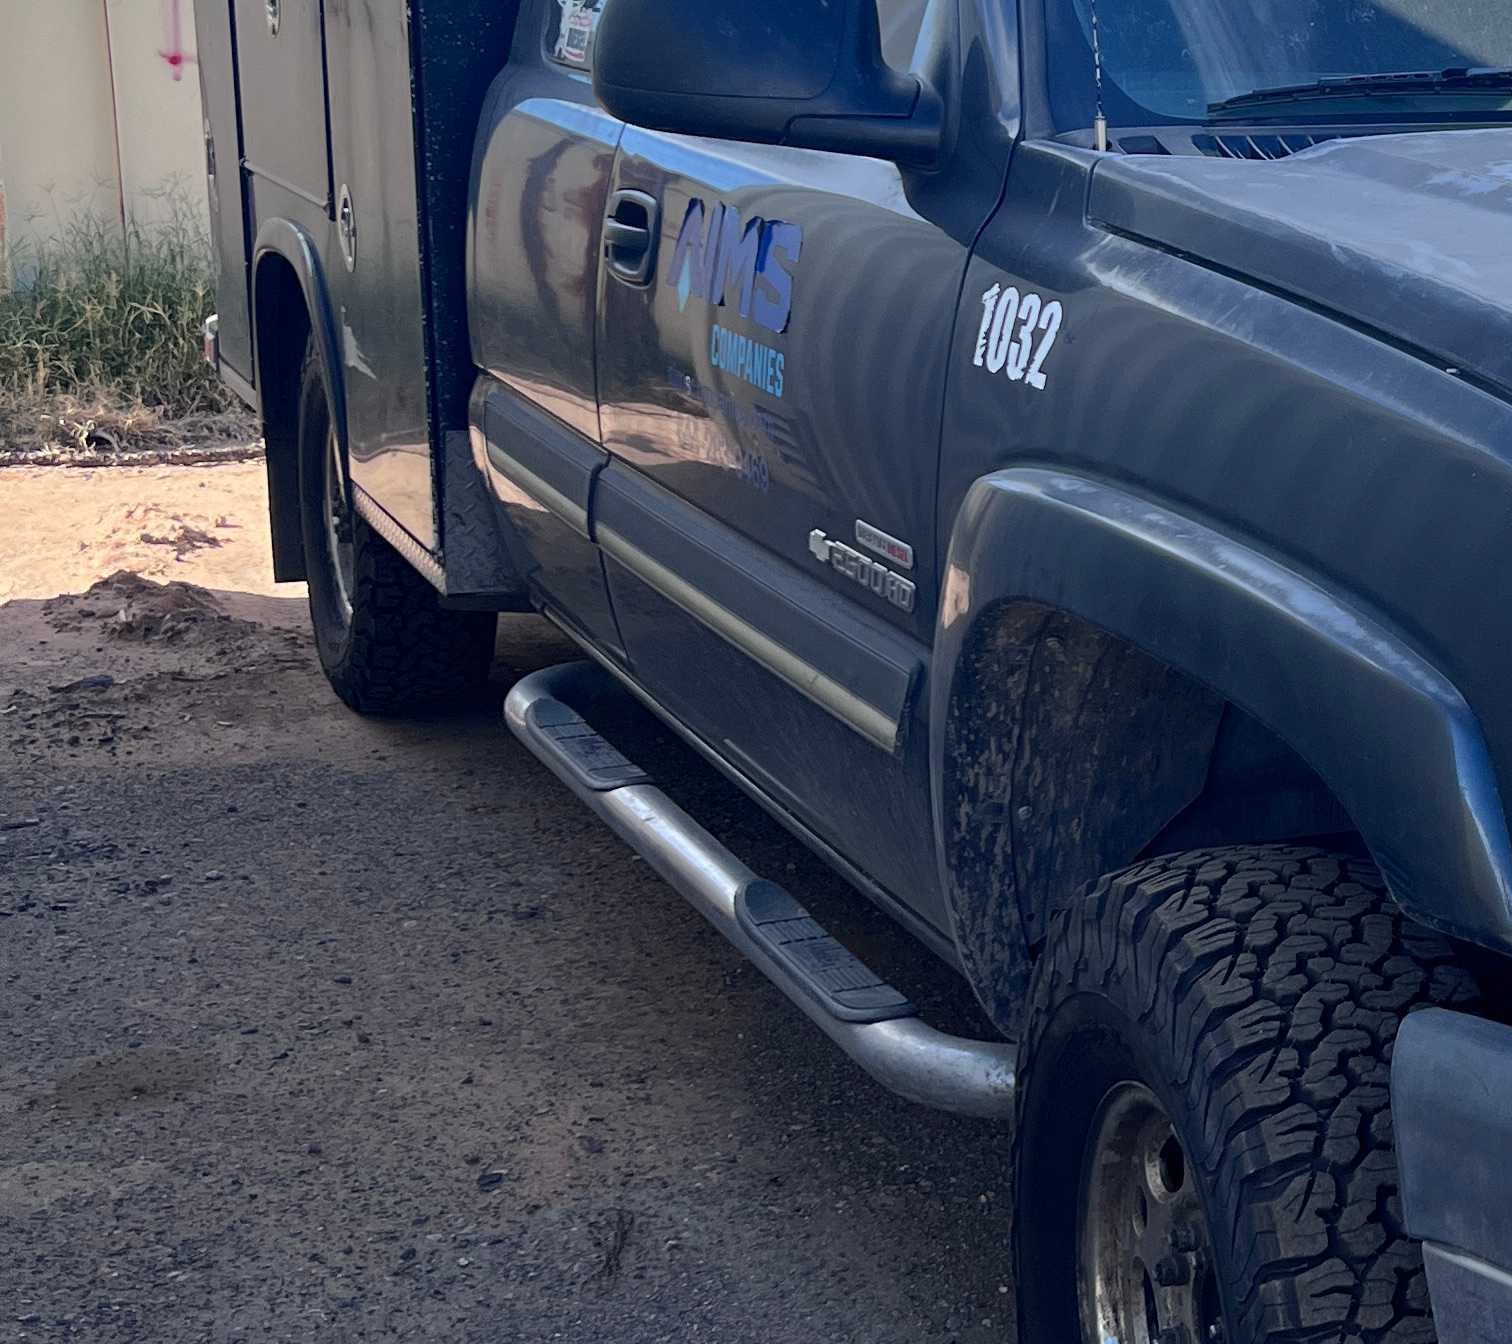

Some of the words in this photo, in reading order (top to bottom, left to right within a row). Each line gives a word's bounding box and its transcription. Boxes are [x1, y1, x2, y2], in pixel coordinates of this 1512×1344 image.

[667, 197, 803, 334] AIMS
[711, 323, 785, 399] COMPANIES
[973, 282, 1063, 391] 1032
